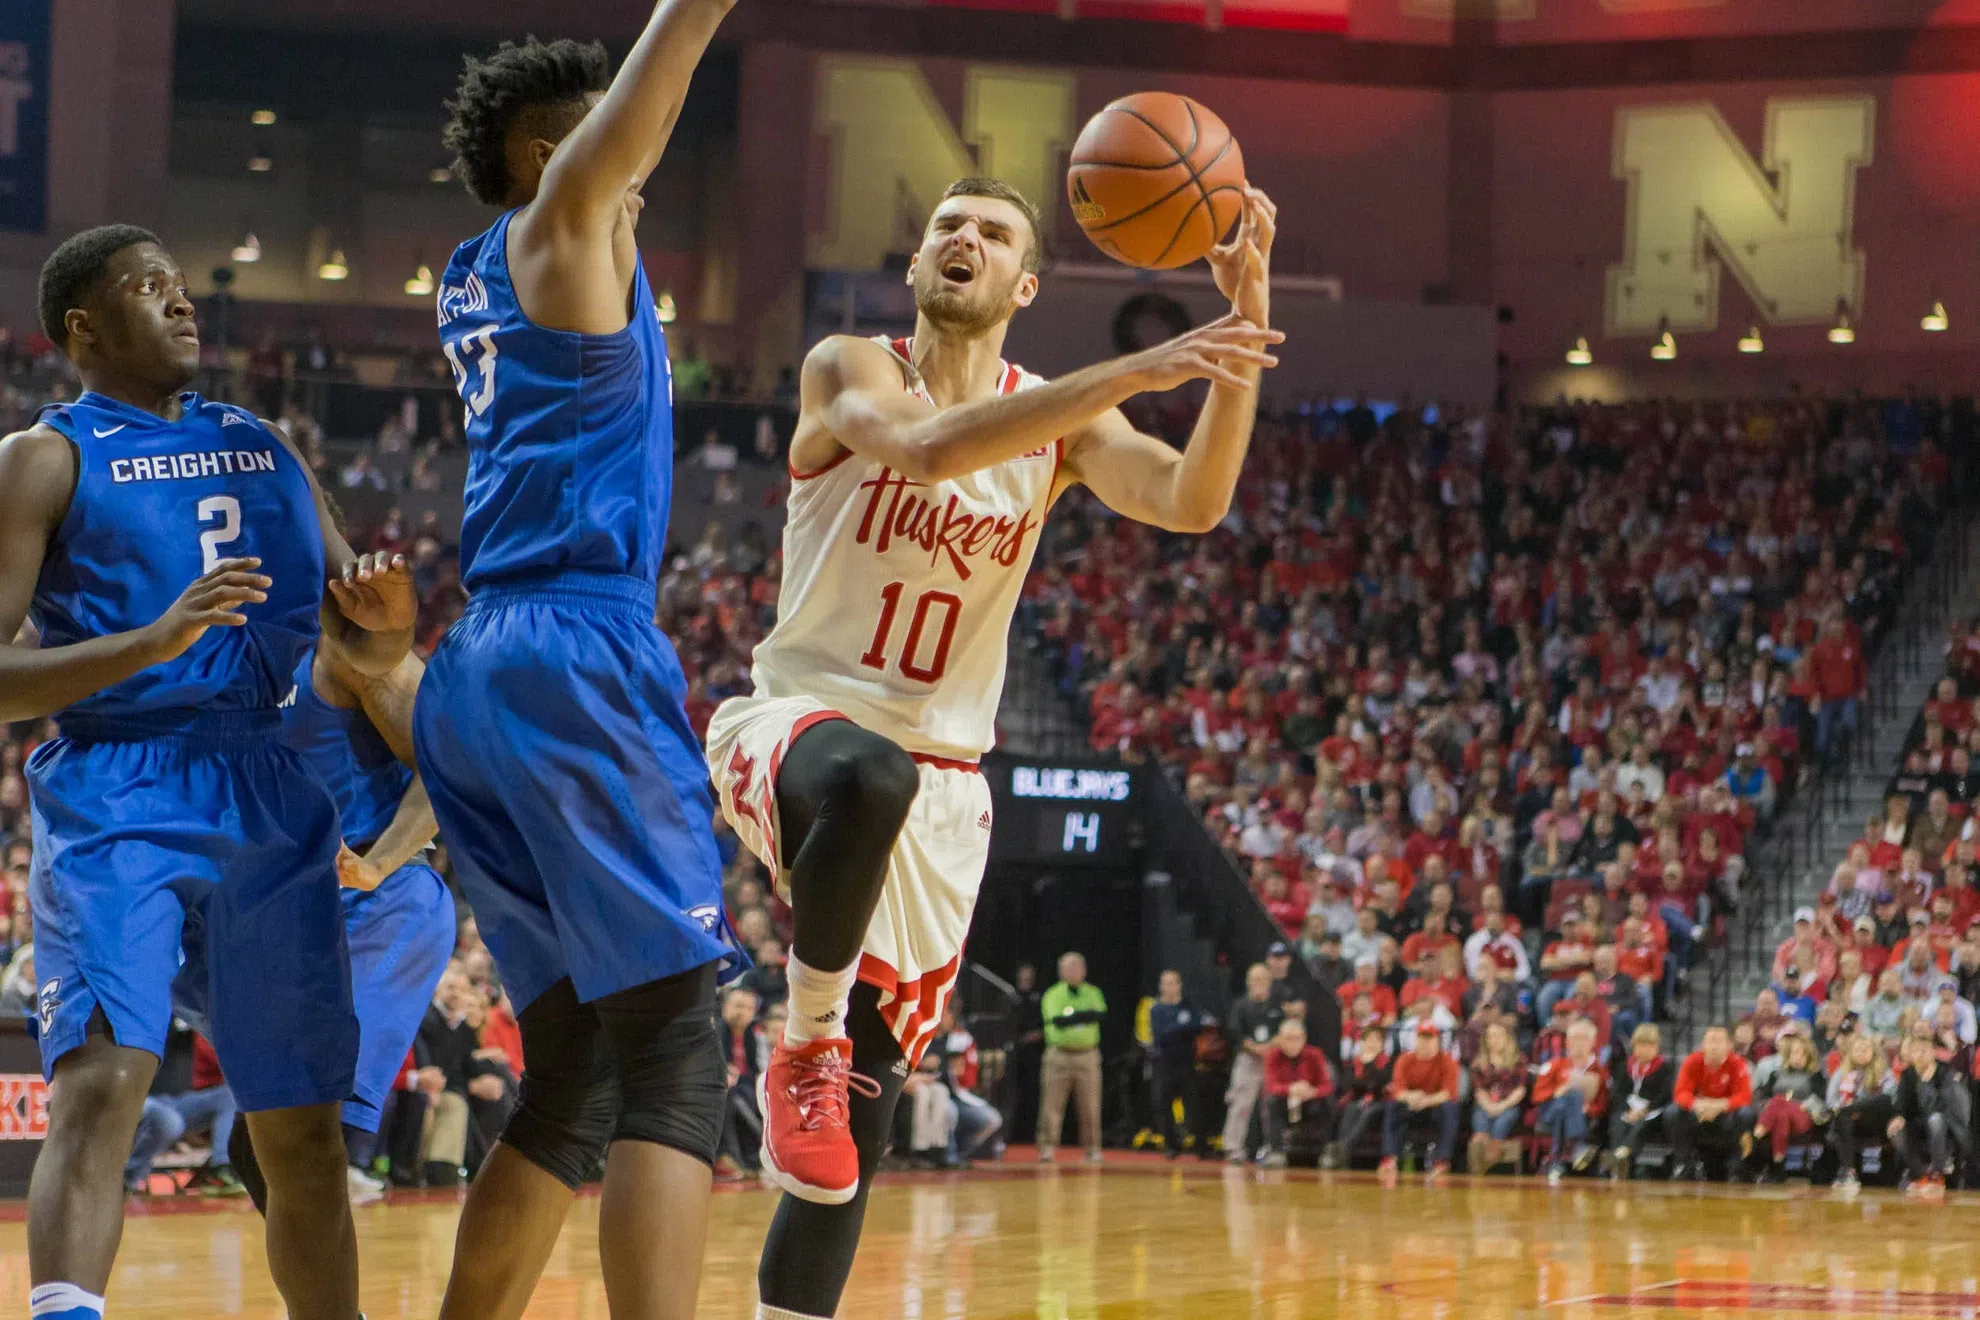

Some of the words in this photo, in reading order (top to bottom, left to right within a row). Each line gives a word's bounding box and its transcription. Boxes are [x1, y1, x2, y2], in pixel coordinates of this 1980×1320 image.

[1604, 94, 1877, 338] N
[110, 449, 277, 483] CREIGHTON
[197, 495, 242, 575] 2
[855, 465, 1039, 582] Huskers
[860, 581, 964, 685] 10
